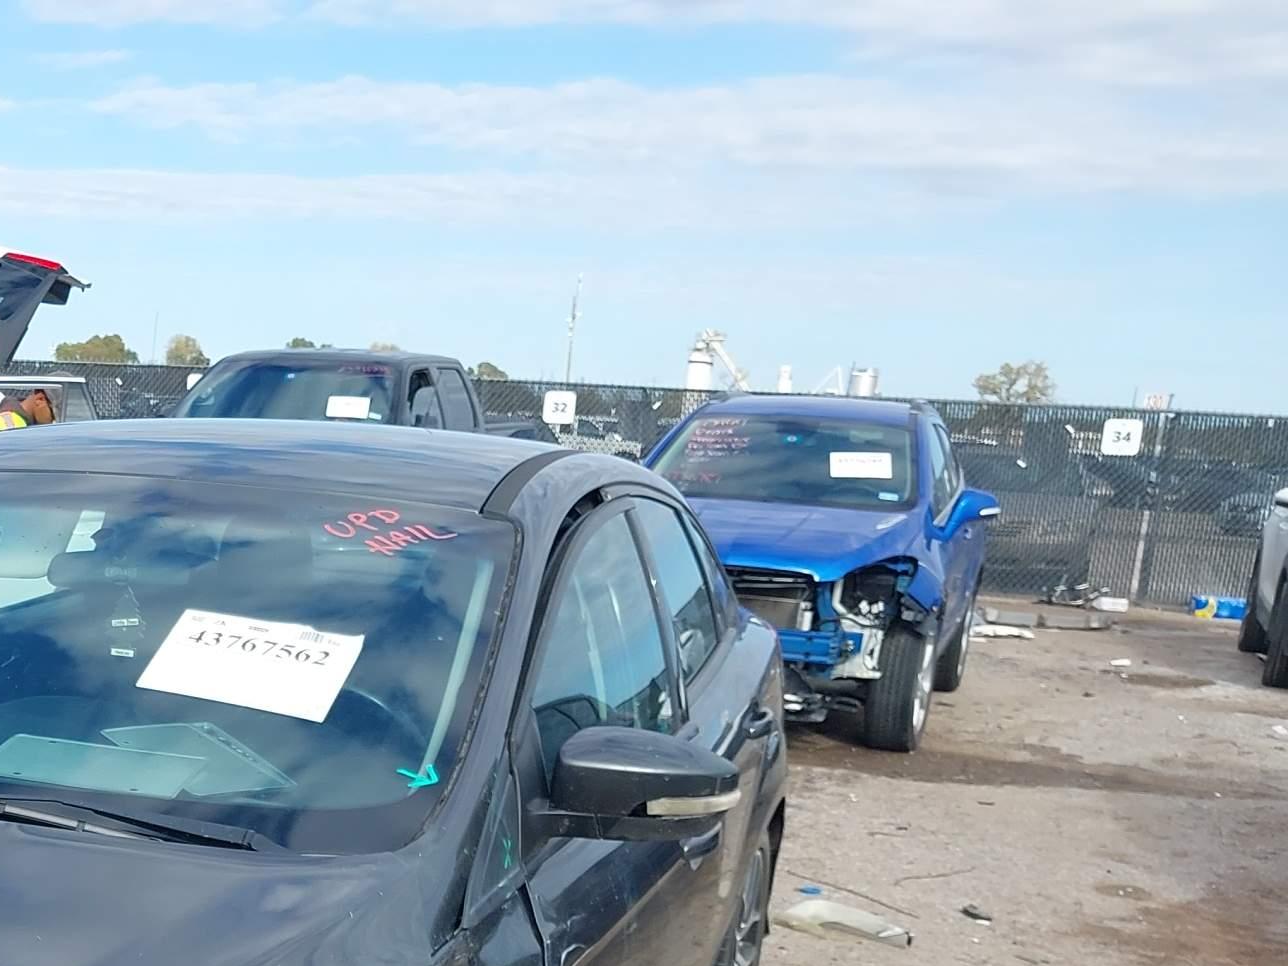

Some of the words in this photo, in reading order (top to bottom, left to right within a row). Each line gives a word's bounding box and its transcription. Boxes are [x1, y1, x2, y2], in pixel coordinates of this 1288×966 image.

[551, 402, 567, 414] 32
[1111, 431, 1131, 443] 34
[188, 629, 331, 666] 43767562
